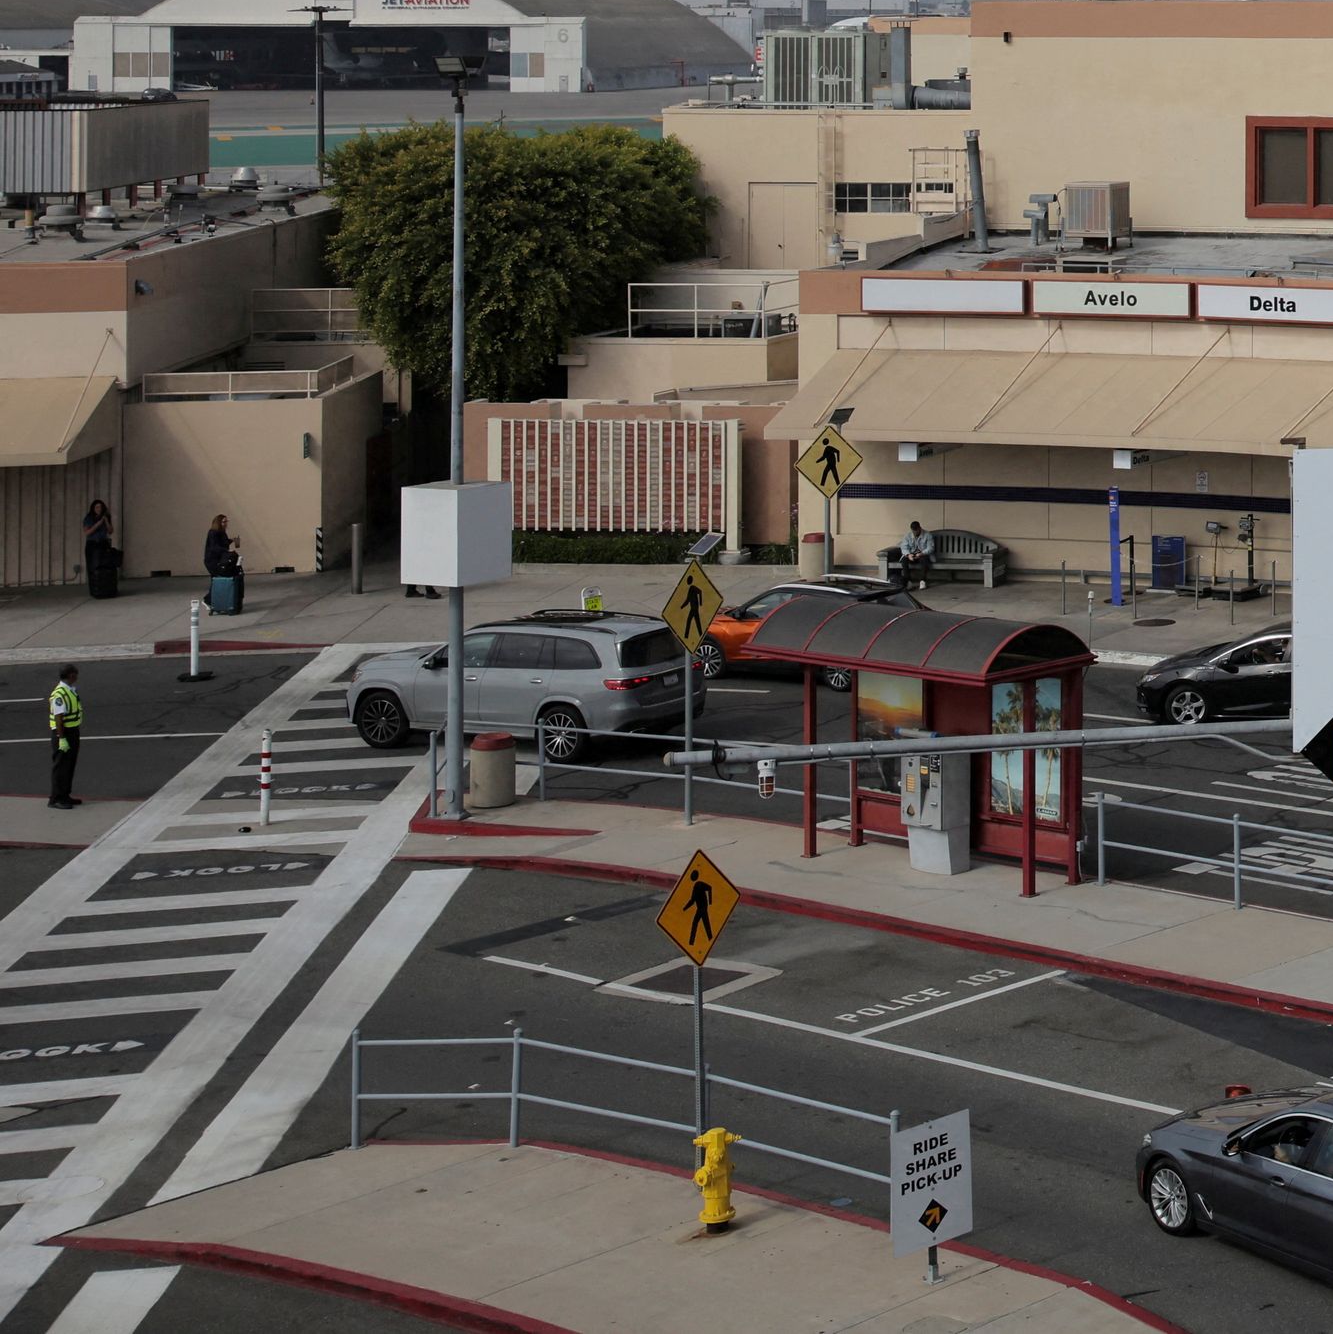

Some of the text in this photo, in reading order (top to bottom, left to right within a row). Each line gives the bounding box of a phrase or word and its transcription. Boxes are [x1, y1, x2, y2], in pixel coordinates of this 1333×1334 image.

[557, 28, 569, 43] 6
[1084, 290, 1138, 307] Avelo
[1249, 295, 1297, 314] Delta
[1132, 454, 1150, 465] Delta
[835, 968, 1016, 1023] POLICE 103
[913, 1132, 949, 1156] RIDE
[905, 1147, 957, 1176] SHARE
[901, 1163, 962, 1196] PICK-UP
